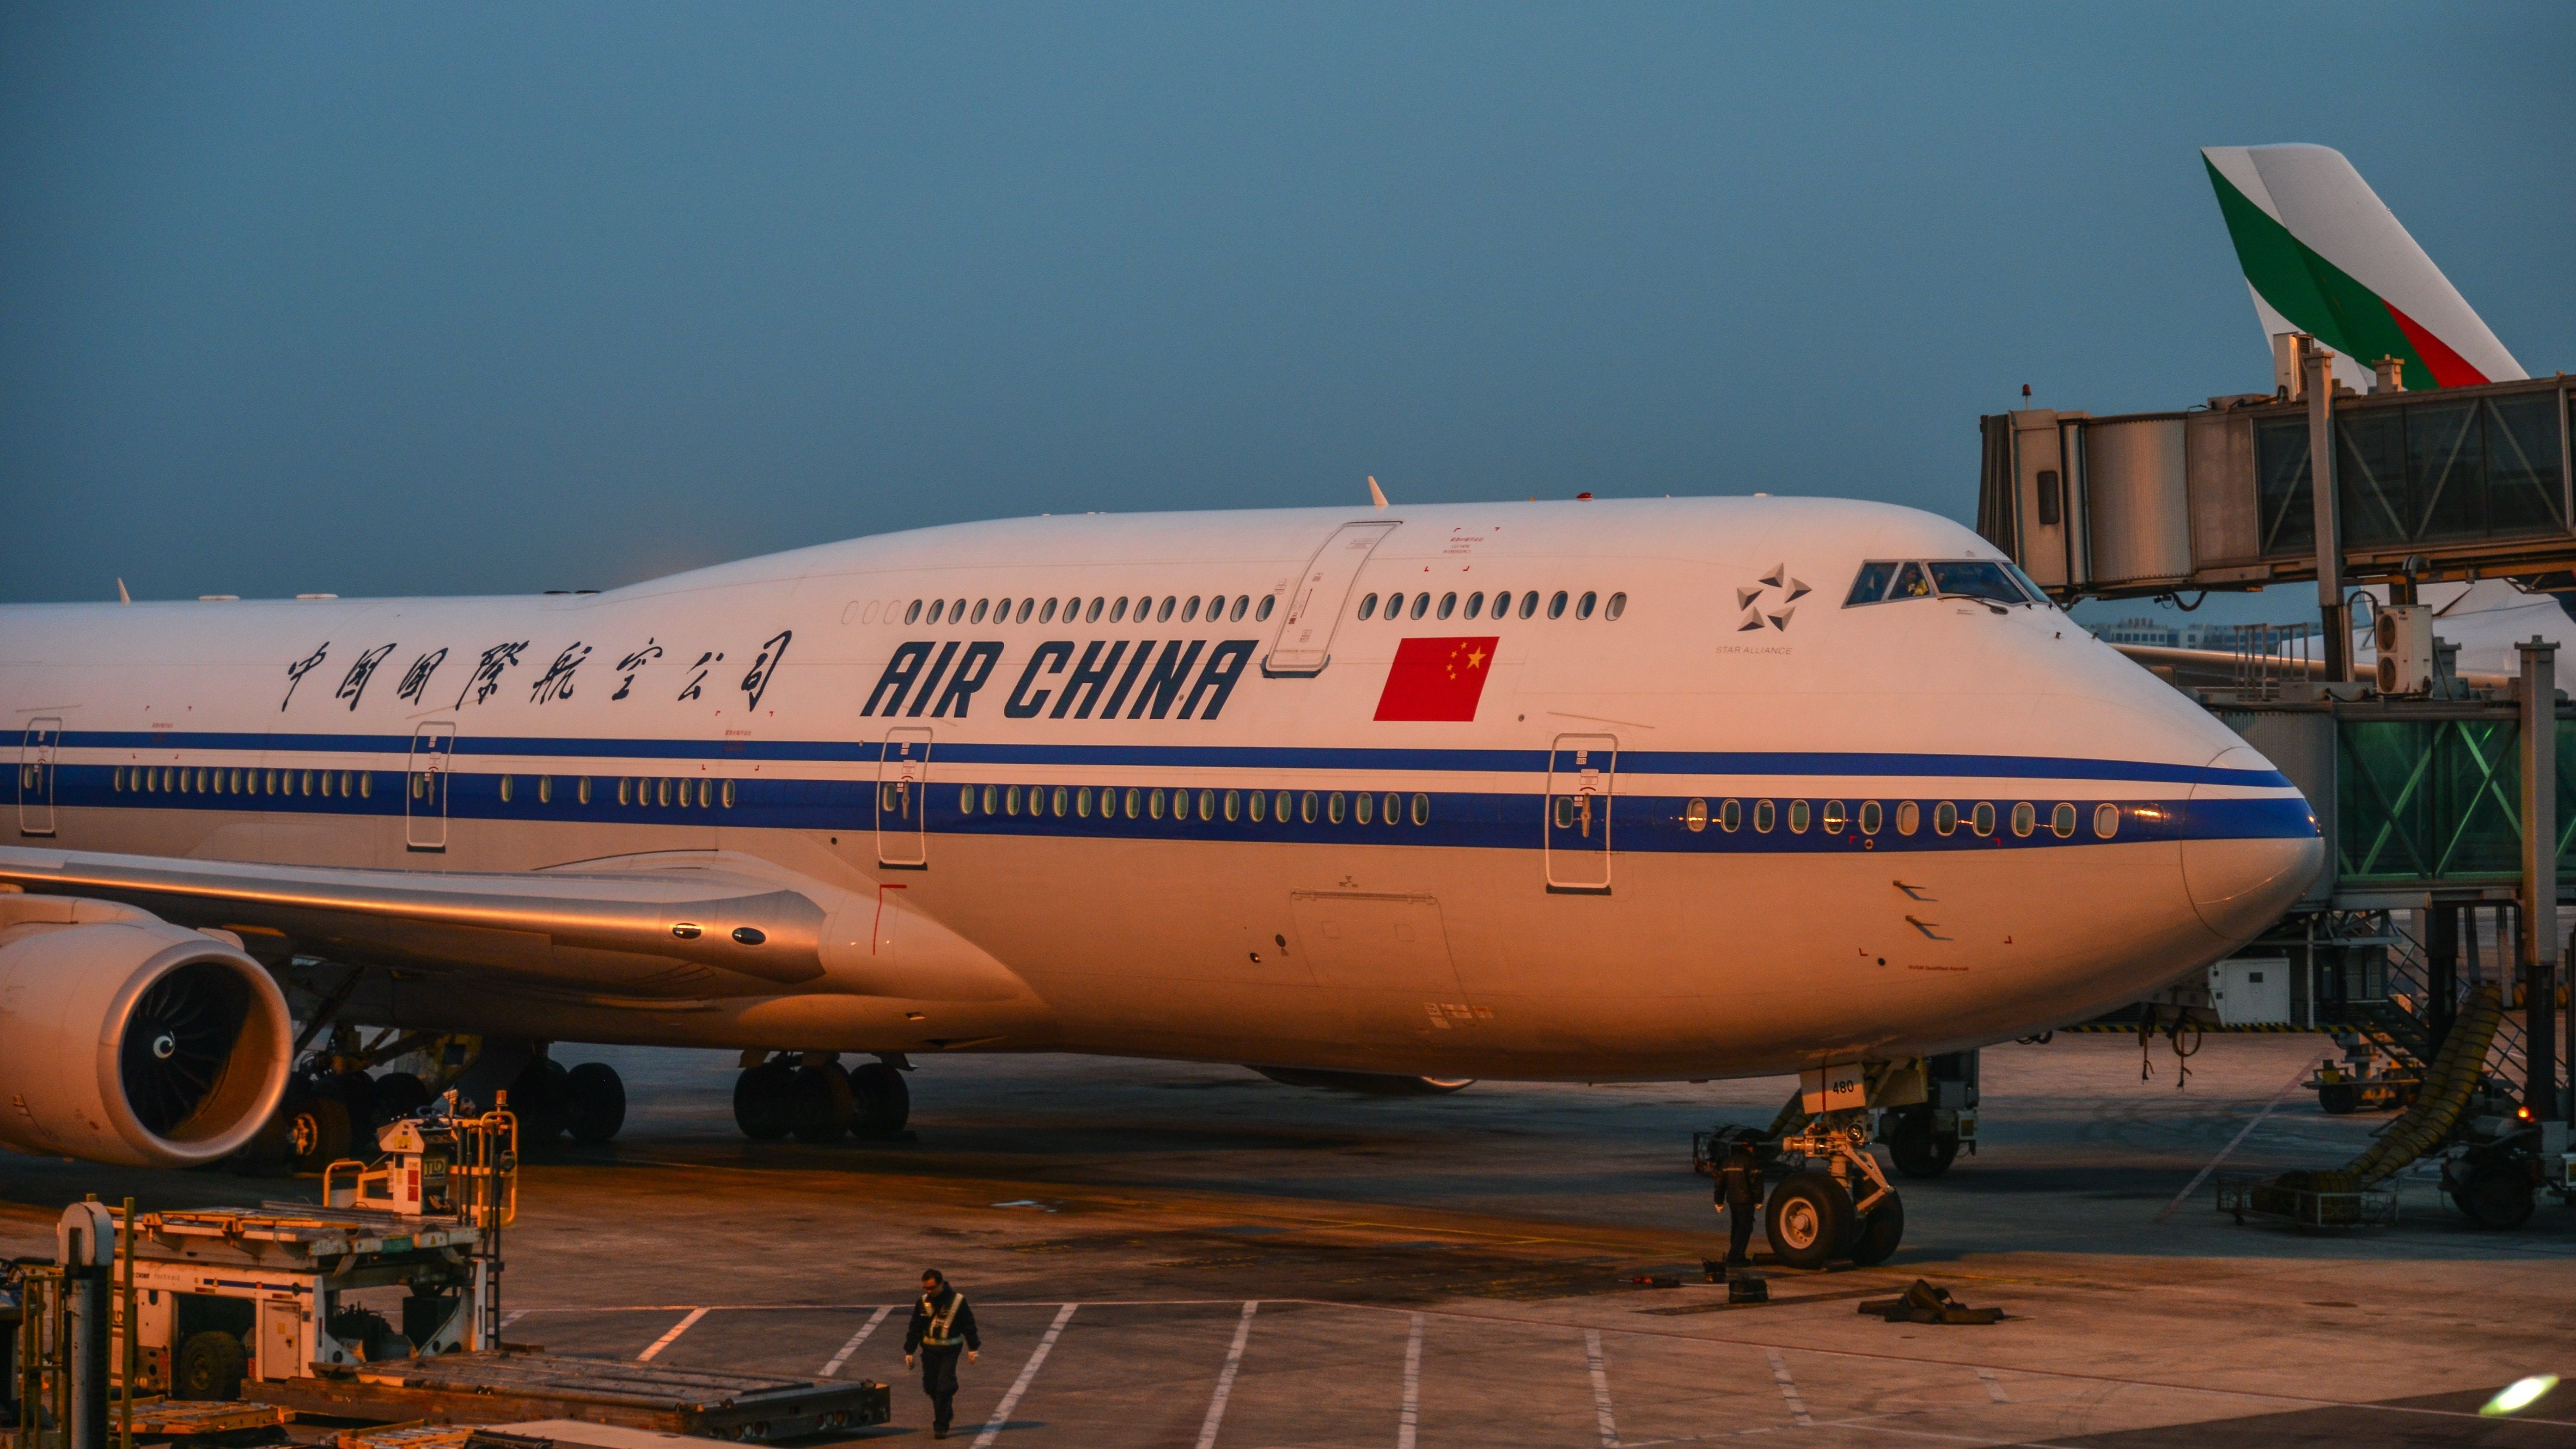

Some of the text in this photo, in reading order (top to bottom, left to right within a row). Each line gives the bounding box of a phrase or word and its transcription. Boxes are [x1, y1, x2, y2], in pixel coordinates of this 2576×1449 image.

[1743, 647, 1793, 655] ALLIANCE
[860, 640, 1260, 720] AIR CHINA
[1833, 1080, 1854, 1094] 480
[424, 1160, 443, 1175] TLD
